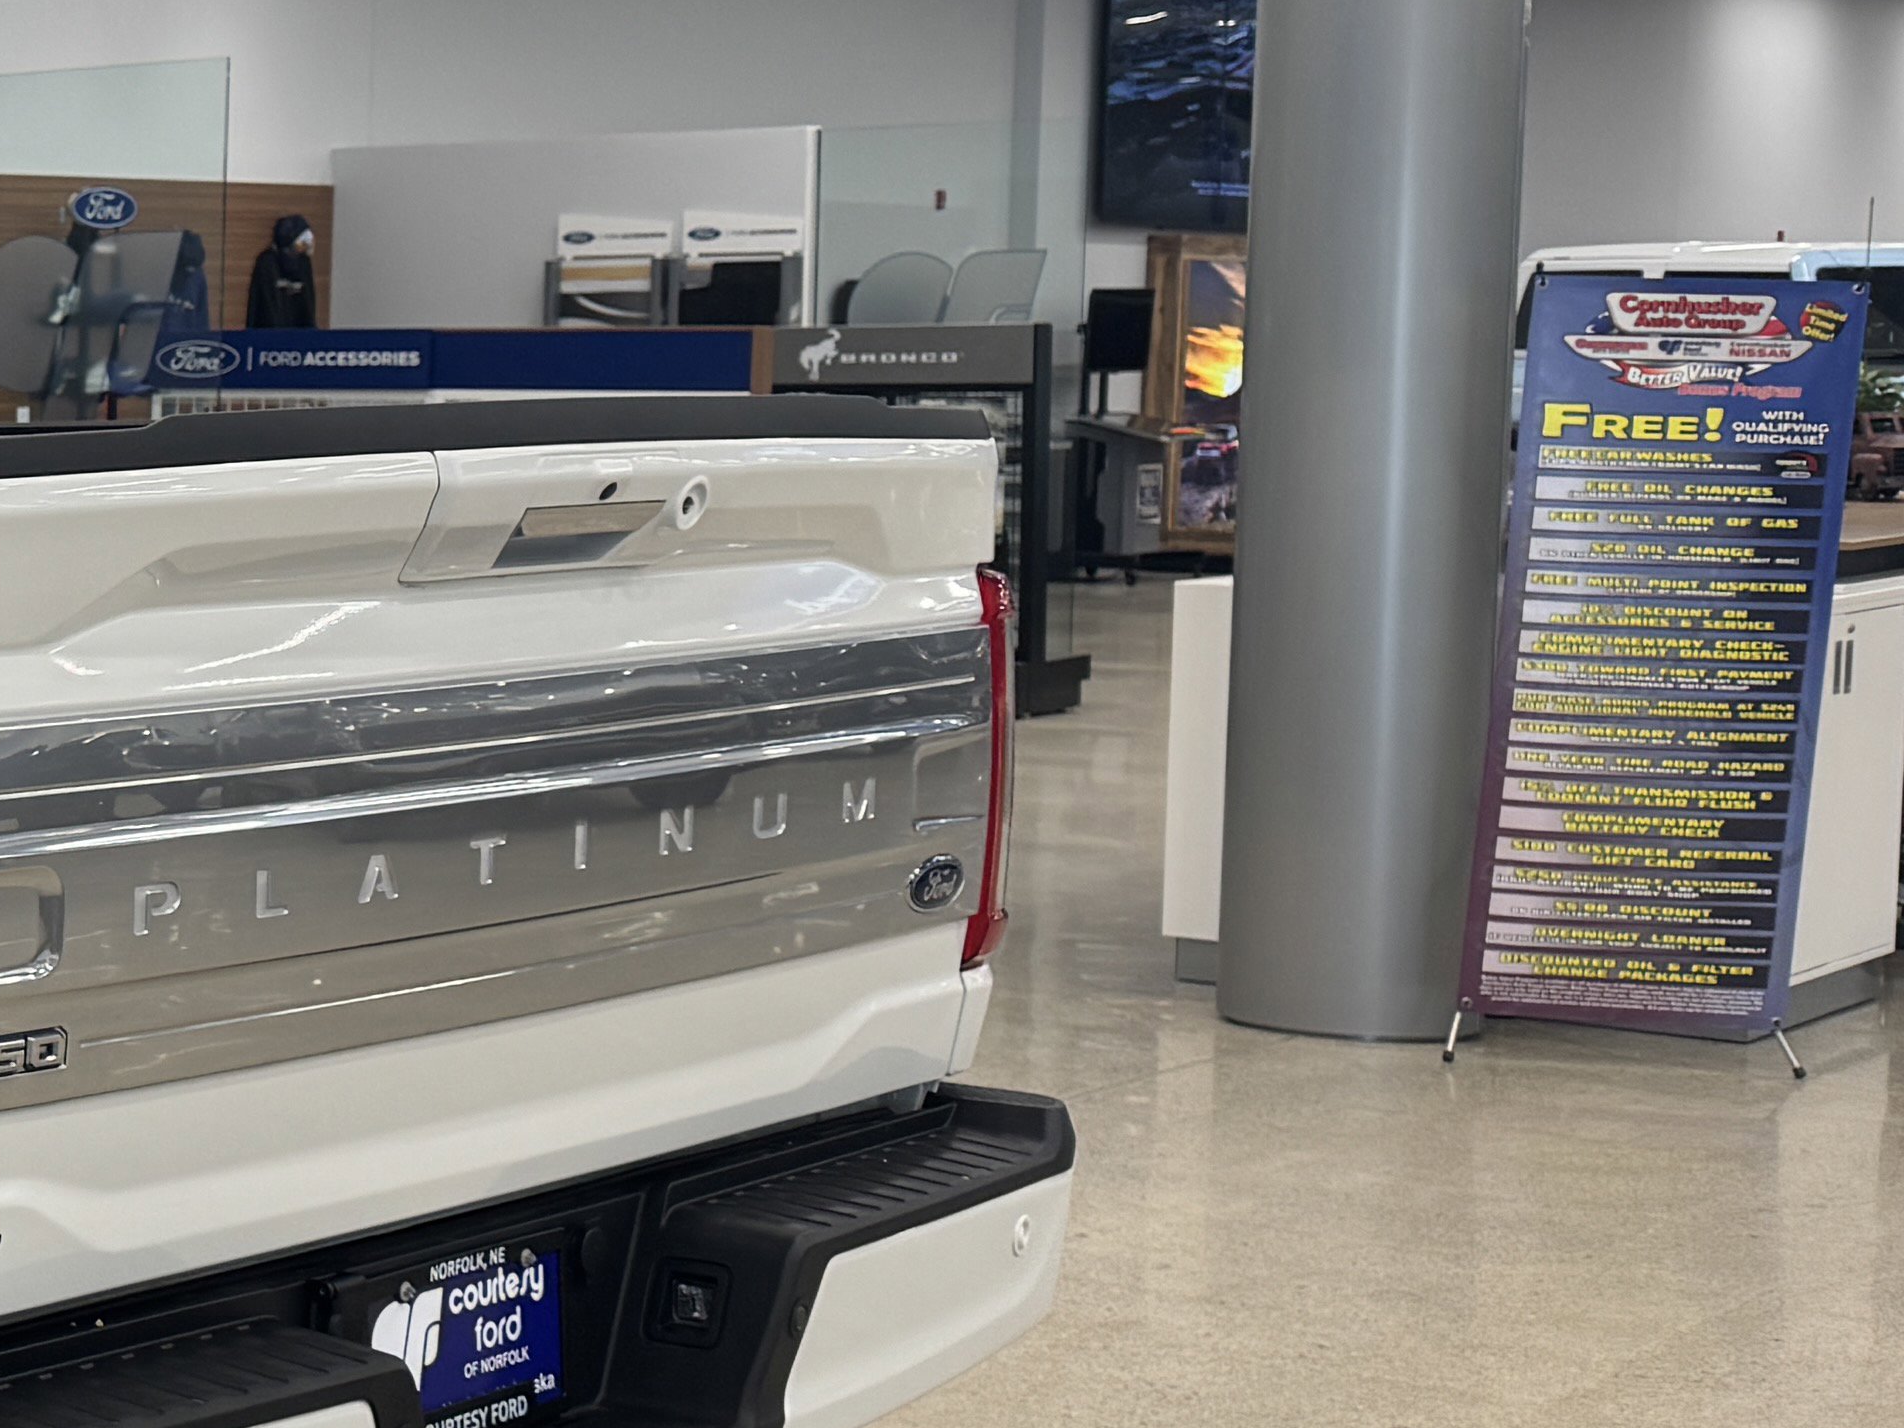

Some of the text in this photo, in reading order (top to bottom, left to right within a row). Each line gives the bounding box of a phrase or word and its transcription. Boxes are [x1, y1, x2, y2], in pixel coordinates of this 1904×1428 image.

[85, 192, 125, 220] Ford
[170, 346, 421, 372] Ford FORD ACCESSORIES
[841, 351, 958, 364] BRONCO
[1729, 348, 1791, 357] NISSAN
[1542, 403, 1724, 442] FREE!
[1762, 411, 1804, 421] WITH
[1732, 422, 1829, 433] QUALIFYING
[1734, 433, 1824, 445] PURCHASE!
[1685, 485, 1774, 496] CHANGES
[1609, 513, 1653, 524] FULL
[1665, 515, 1715, 526] TANK
[1726, 517, 1751, 527] OF
[1761, 518, 1799, 529] GAS
[1678, 546, 1755, 557] CHANGE
[1648, 578, 1700, 590] POINT
[1710, 581, 1807, 593] INSPECTION
[1624, 606, 1713, 619] DISCOUNT
[1723, 609, 1748, 619] ON
[1702, 619, 1776, 631] SERVICE
[1680, 649, 1790, 661] DIAGNOSTIC
[1717, 669, 1794, 680] PAYMENT
[1686, 730, 1789, 743] ALIGNMENT
[1614, 786, 1751, 800] TRANSMISSION
[1660, 826, 1720, 838] CHECK
[133, 777, 876, 936] PLATINUM
[1679, 847, 1773, 861] REFERRAL
[1592, 854, 1696, 869] GIFT CARD
[1619, 904, 1712, 917] DISCOUNT
[1651, 933, 1727, 946] LOANER
[1691, 963, 1754, 976] FILTER
[430, 1247, 506, 1282] NORFOLK, NE
[449, 1263, 545, 1315] courtesy
[474, 1305, 522, 1352] ford
[464, 1346, 531, 1378] OF NORFOLK
[491, 1395, 529, 1424] FORD
